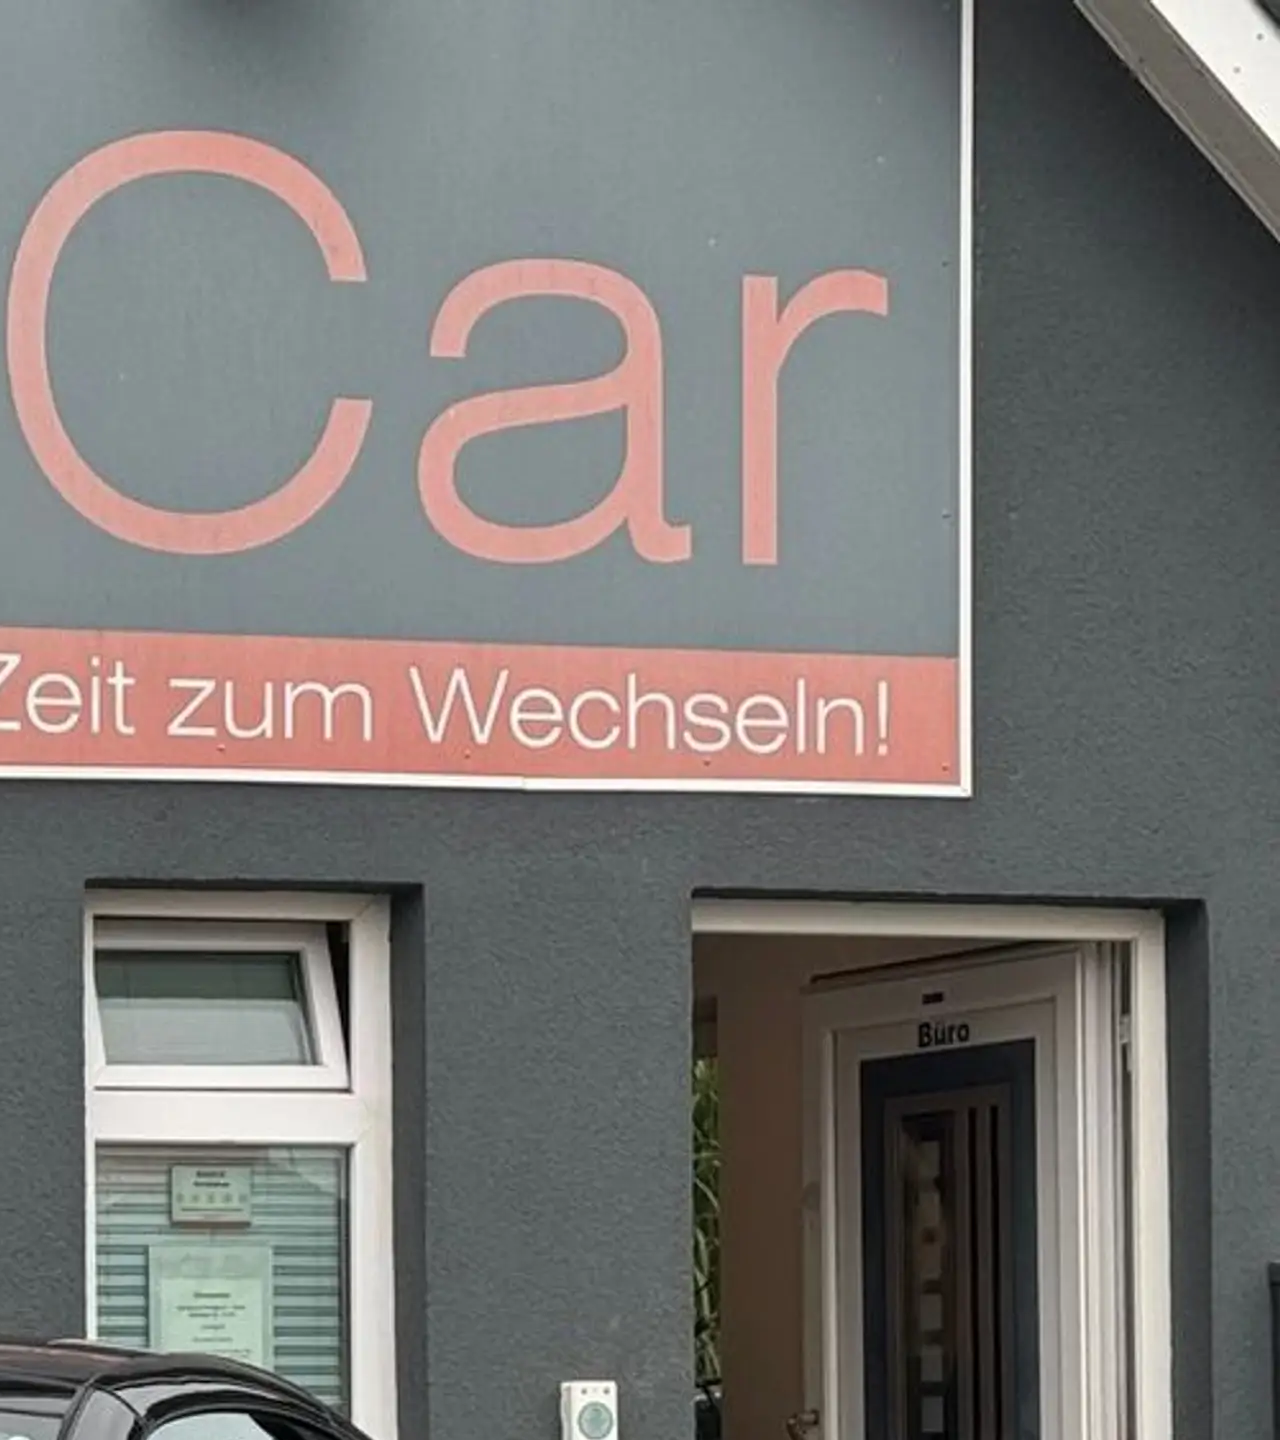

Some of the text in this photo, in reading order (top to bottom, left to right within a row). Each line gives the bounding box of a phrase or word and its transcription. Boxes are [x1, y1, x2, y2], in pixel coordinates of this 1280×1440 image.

[5, 129, 890, 567] Car
[166, 677, 374, 748] zum
[410, 665, 891, 756] Wechseln!
[917, 1017, 970, 1048] Büro
